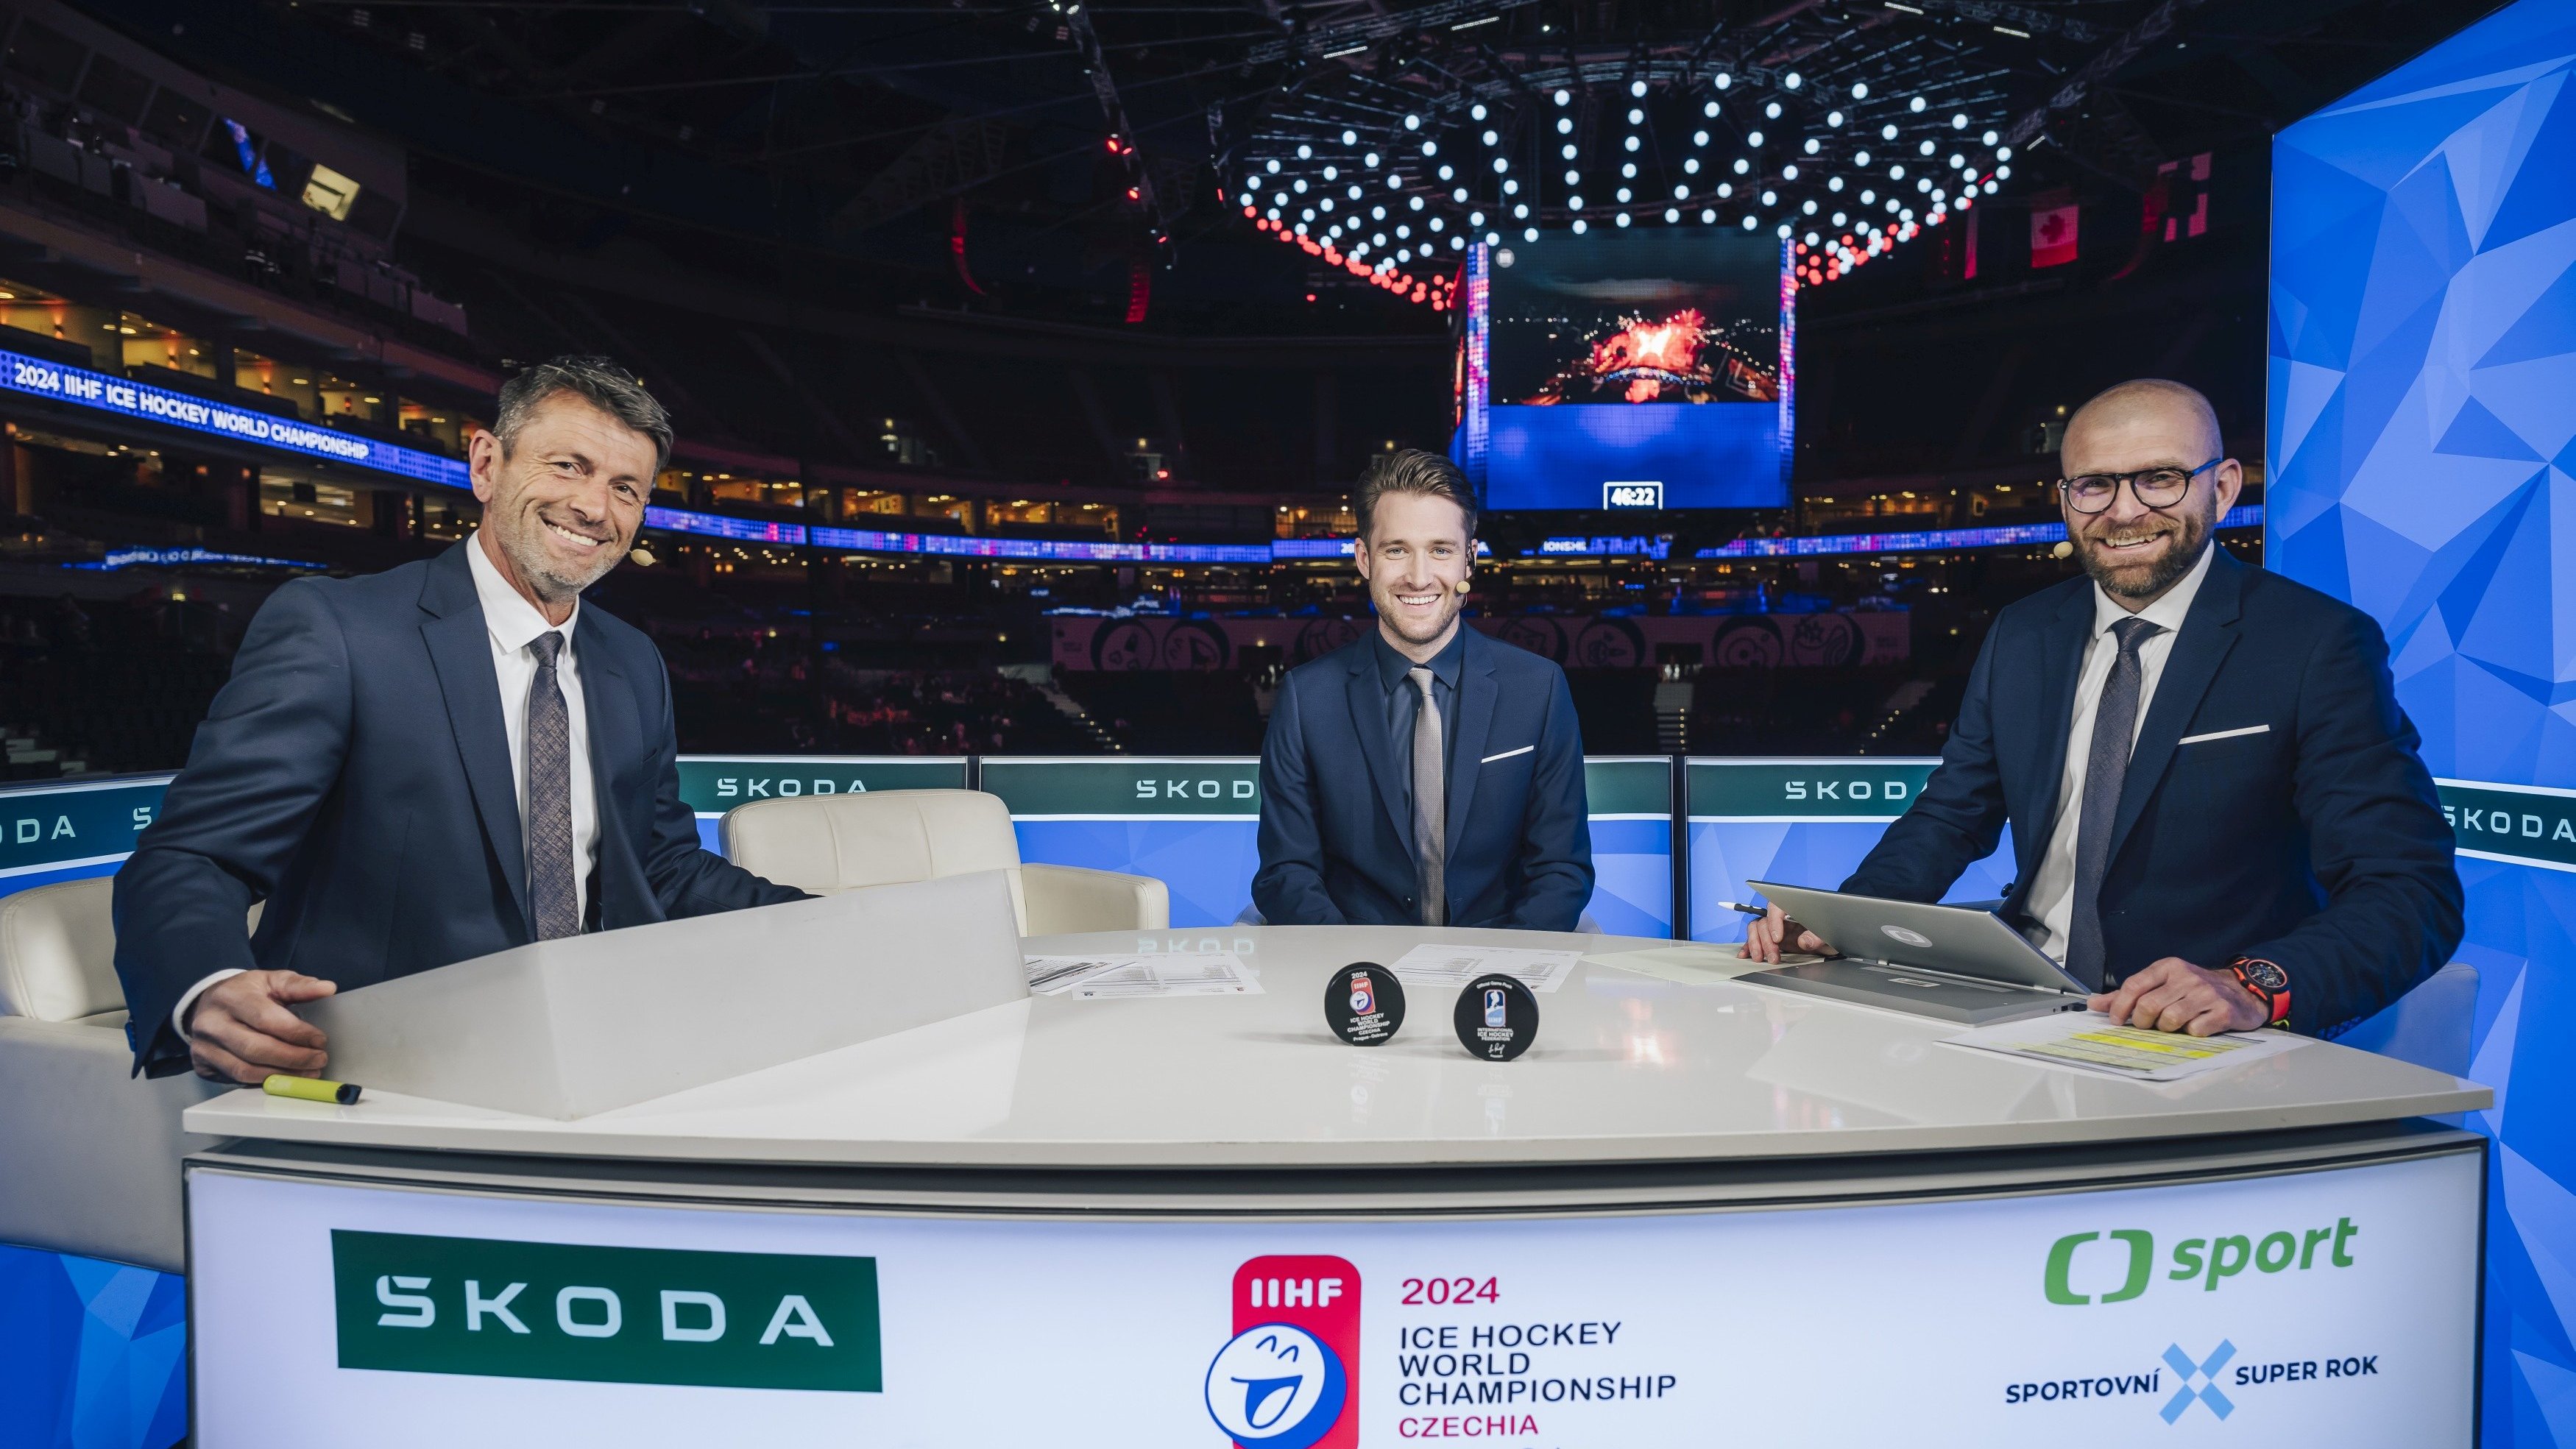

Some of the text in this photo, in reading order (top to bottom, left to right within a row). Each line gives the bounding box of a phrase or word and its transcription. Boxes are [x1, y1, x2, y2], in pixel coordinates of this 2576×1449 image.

[15, 363, 369, 459] 2024 IIHF ICE HOCKEY WORLD CHAMPIONSHIP
[1610, 487, 1655, 506] 46:22
[1786, 781, 1928, 800] SKOD
[1351, 971, 1367, 979] 2024
[2168, 1216, 2358, 1292] sport
[1251, 1278, 1342, 1308] IIHF
[1401, 1276, 1500, 1305] 2024
[1401, 1321, 1621, 1350] ICE HOCKEY
[1399, 1353, 1530, 1378] WORLD
[2006, 1356, 2379, 1403] SPORTOVNÍ SUPER ROK
[1399, 1375, 1677, 1406] CHAMPIONSHIP
[1399, 1414, 1539, 1438] CZECHIA
